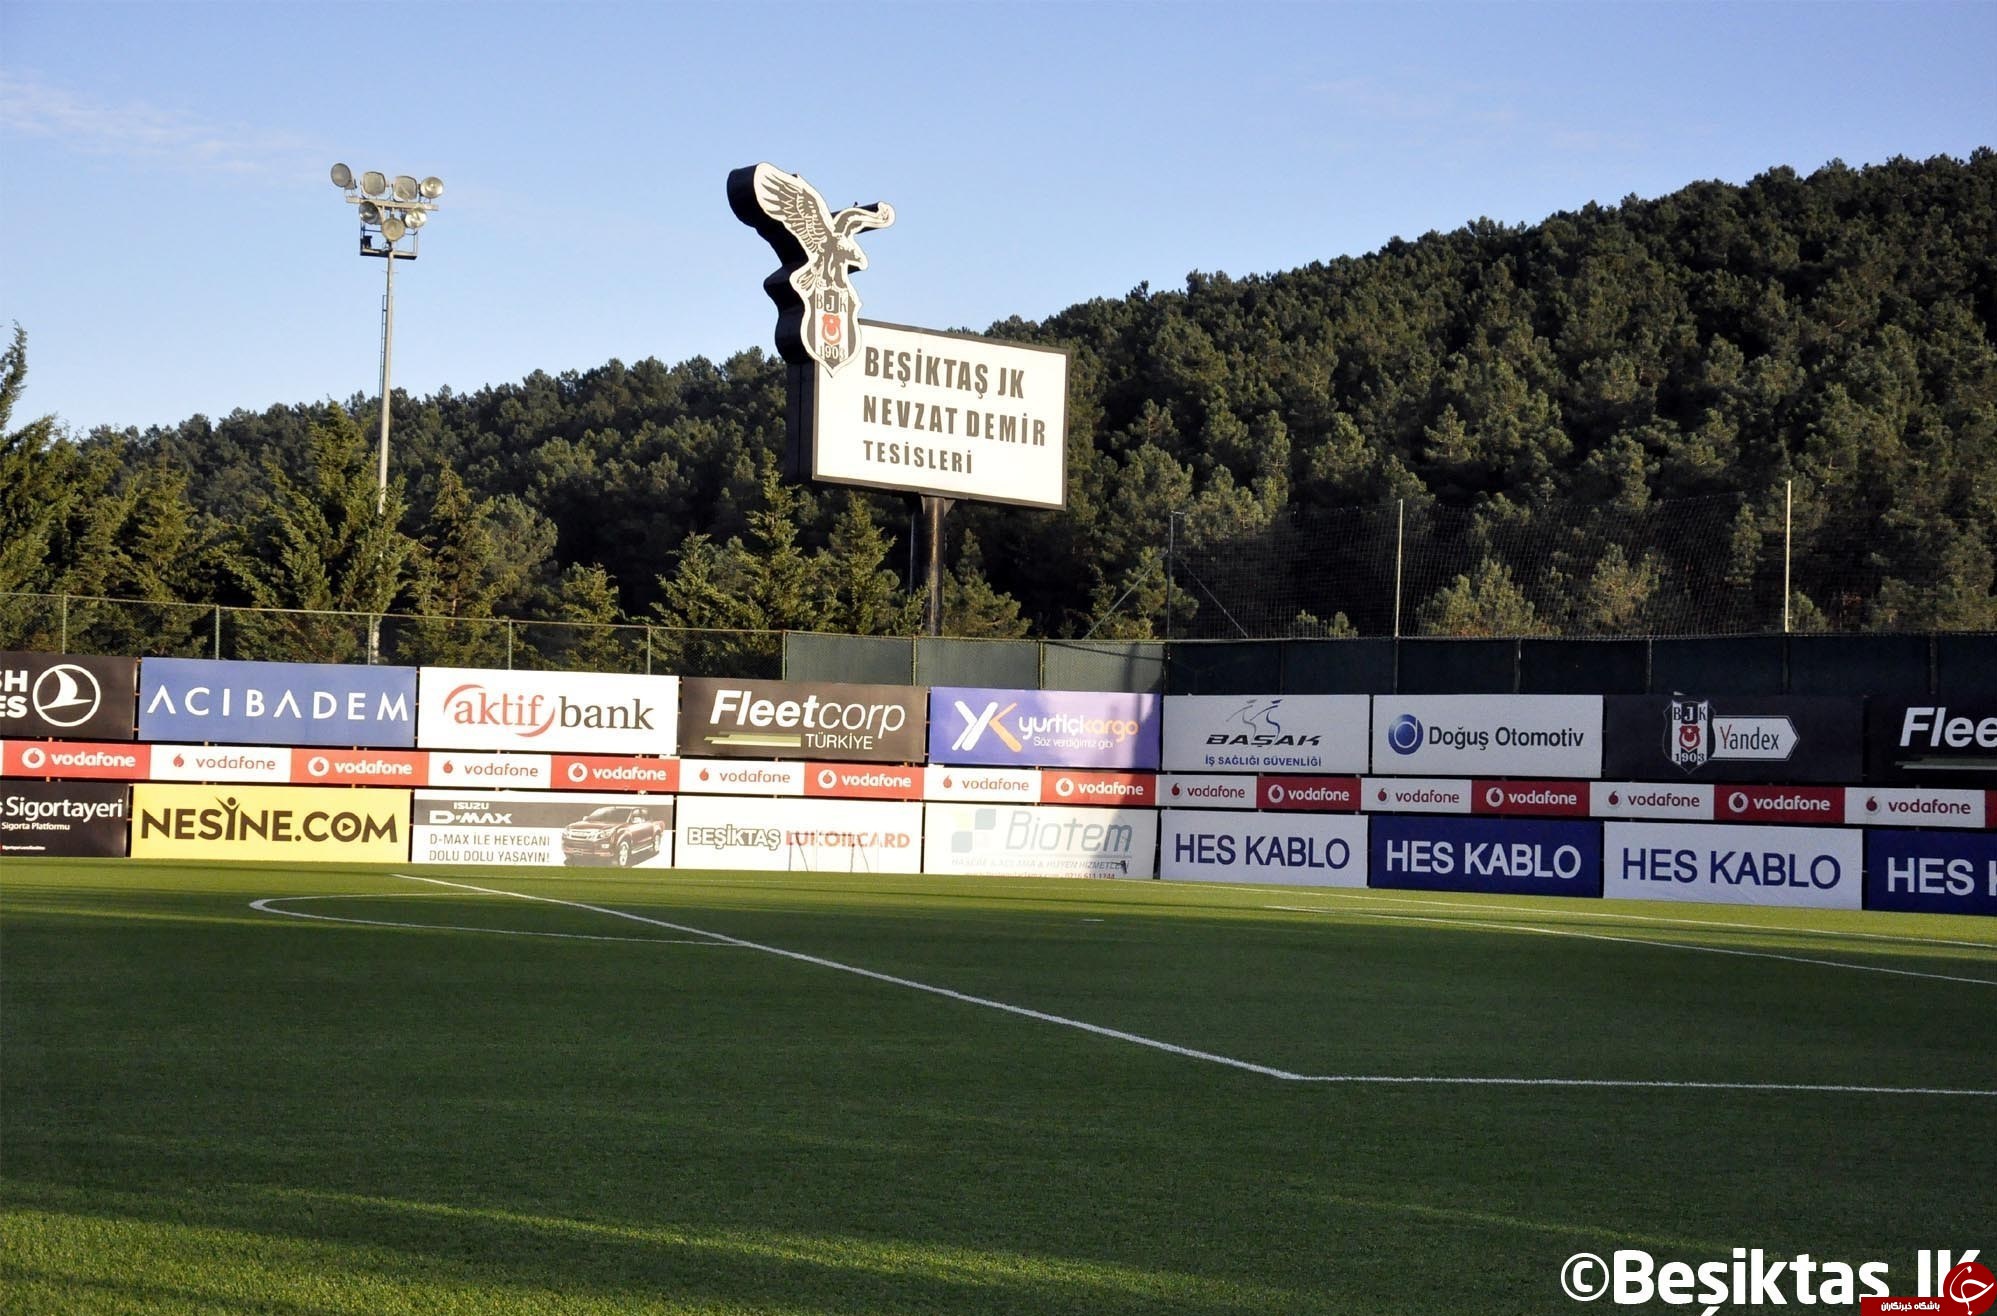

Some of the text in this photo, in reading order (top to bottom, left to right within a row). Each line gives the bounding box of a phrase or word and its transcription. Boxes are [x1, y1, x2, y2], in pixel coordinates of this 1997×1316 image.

[816, 293, 847, 312] BJK
[864, 345, 1025, 400] BEŞİKTAŞ JK
[863, 395, 1046, 446] NEVZAT DEMİR
[863, 440, 973, 474] TESİSLERİ
[146, 684, 410, 722] ACIBADEM
[453, 691, 655, 731] aktif bank
[709, 689, 906, 739] Fleetcorp
[1673, 706, 1707, 721] BJK
[804, 732, 873, 751] TÜRKİYE
[1205, 734, 1323, 748] BAŞAK
[1428, 725, 1585, 751] Doğuş Otomotiv
[1719, 723, 1780, 750] Yandex
[51, 752, 136, 768] vodafone
[195, 754, 276, 771] vodafone
[1218, 755, 1260, 766] SAĞLIĞI
[1675, 752, 1706, 763] 1903
[334, 761, 413, 776] vodafone
[464, 763, 539, 778] vodafone
[592, 766, 667, 782] vodafone
[719, 769, 791, 784] vodafone
[841, 773, 912, 789] vodafone
[961, 775, 1030, 792] vodafone
[1077, 780, 1145, 796] vodafone
[1187, 785, 1246, 799] vodafone
[1288, 786, 1350, 802] vodafone
[1395, 788, 1460, 804] vodafone
[1508, 790, 1578, 806] vodafone
[1627, 791, 1701, 809] vodafone
[5, 796, 123, 823] Sigortayeri
[453, 801, 490, 810] ISUZU
[1753, 794, 1831, 812] vodafone
[1888, 798, 1972, 815] vodafone
[688, 824, 782, 851] BEŞİKTAŞ
[1005, 809, 1132, 851] Biotem
[430, 833, 469, 845] D-MAX
[494, 834, 550, 846] HEYECANI
[429, 850, 460, 861] DOLU
[464, 850, 495, 862] DOLU
[1174, 833, 1350, 869] HES KABLO
[1386, 839, 1581, 879] HES KABLO
[1623, 847, 1841, 889] HES KABLO
[1887, 856, 1975, 896] HES
